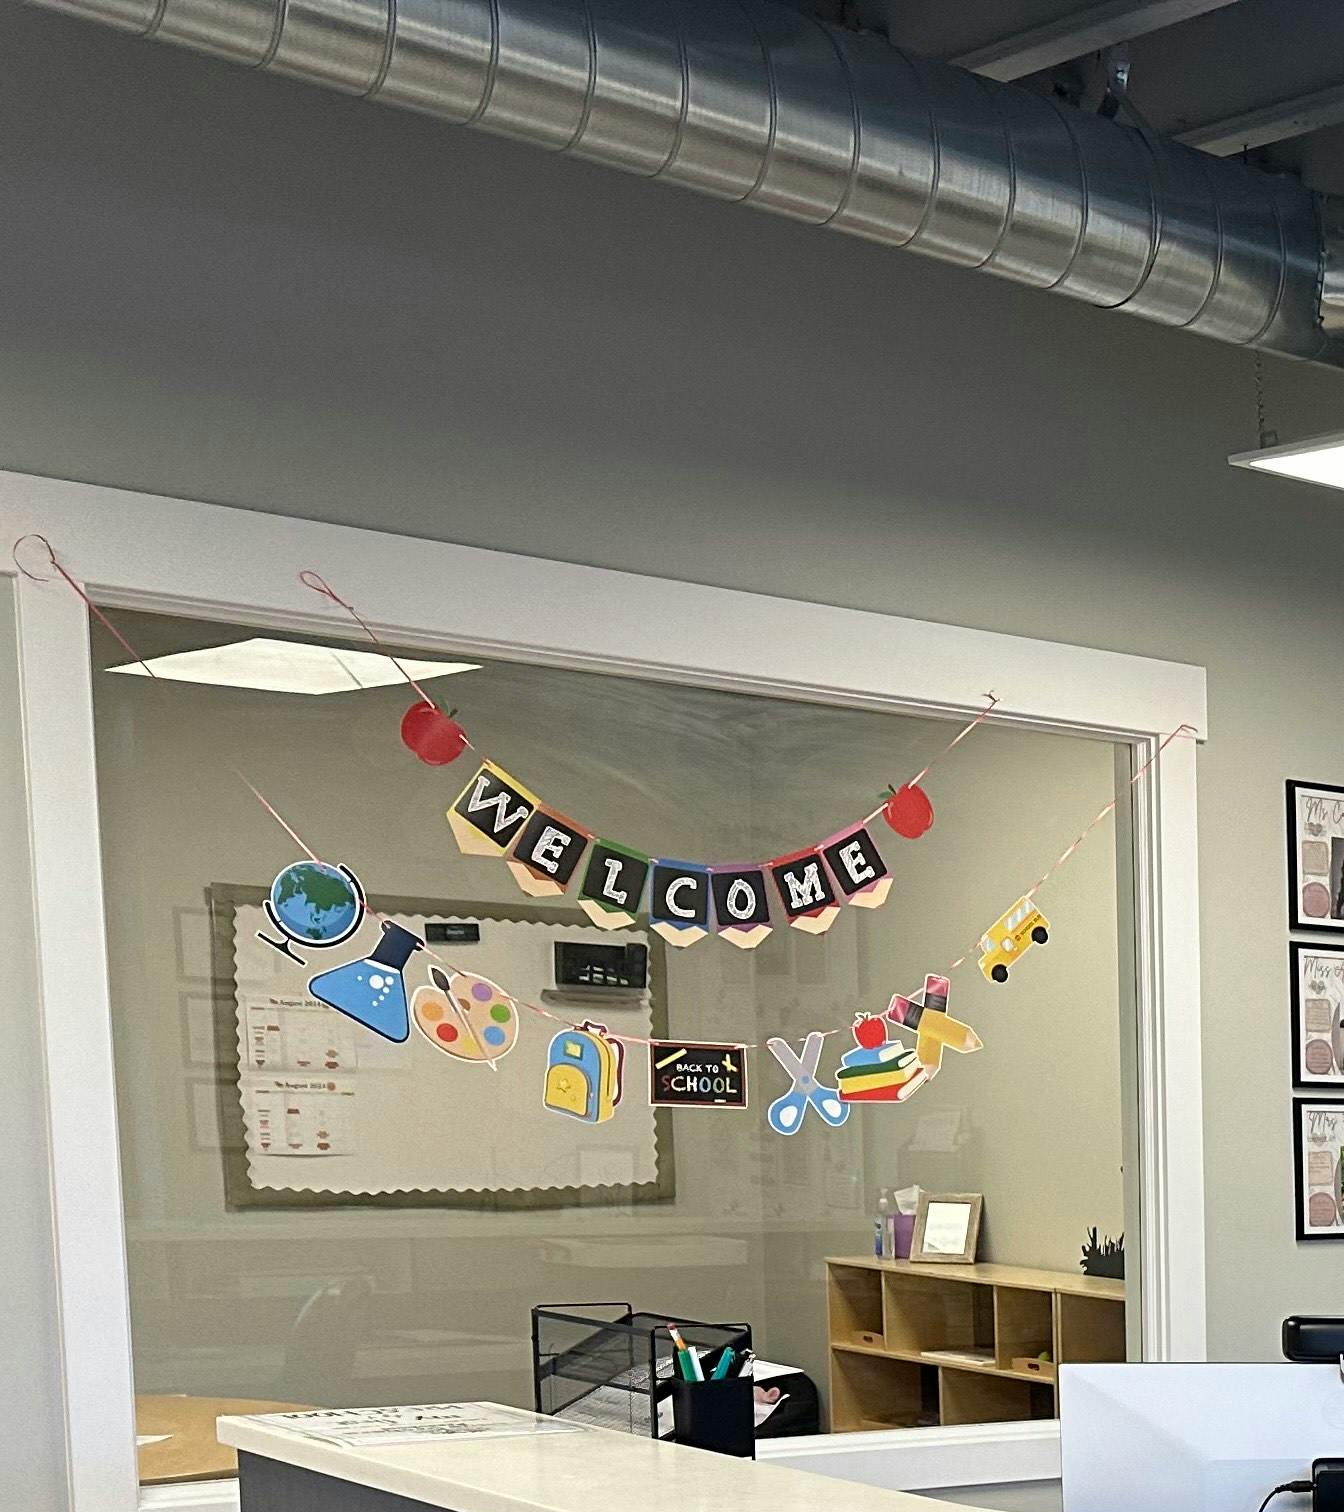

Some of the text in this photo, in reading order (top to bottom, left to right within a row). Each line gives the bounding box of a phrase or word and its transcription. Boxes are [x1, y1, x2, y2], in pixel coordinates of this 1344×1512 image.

[467, 775, 876, 920] WELCOME
[676, 1063, 718, 1074] BACK TO
[661, 1075, 737, 1094] SCHOOL
